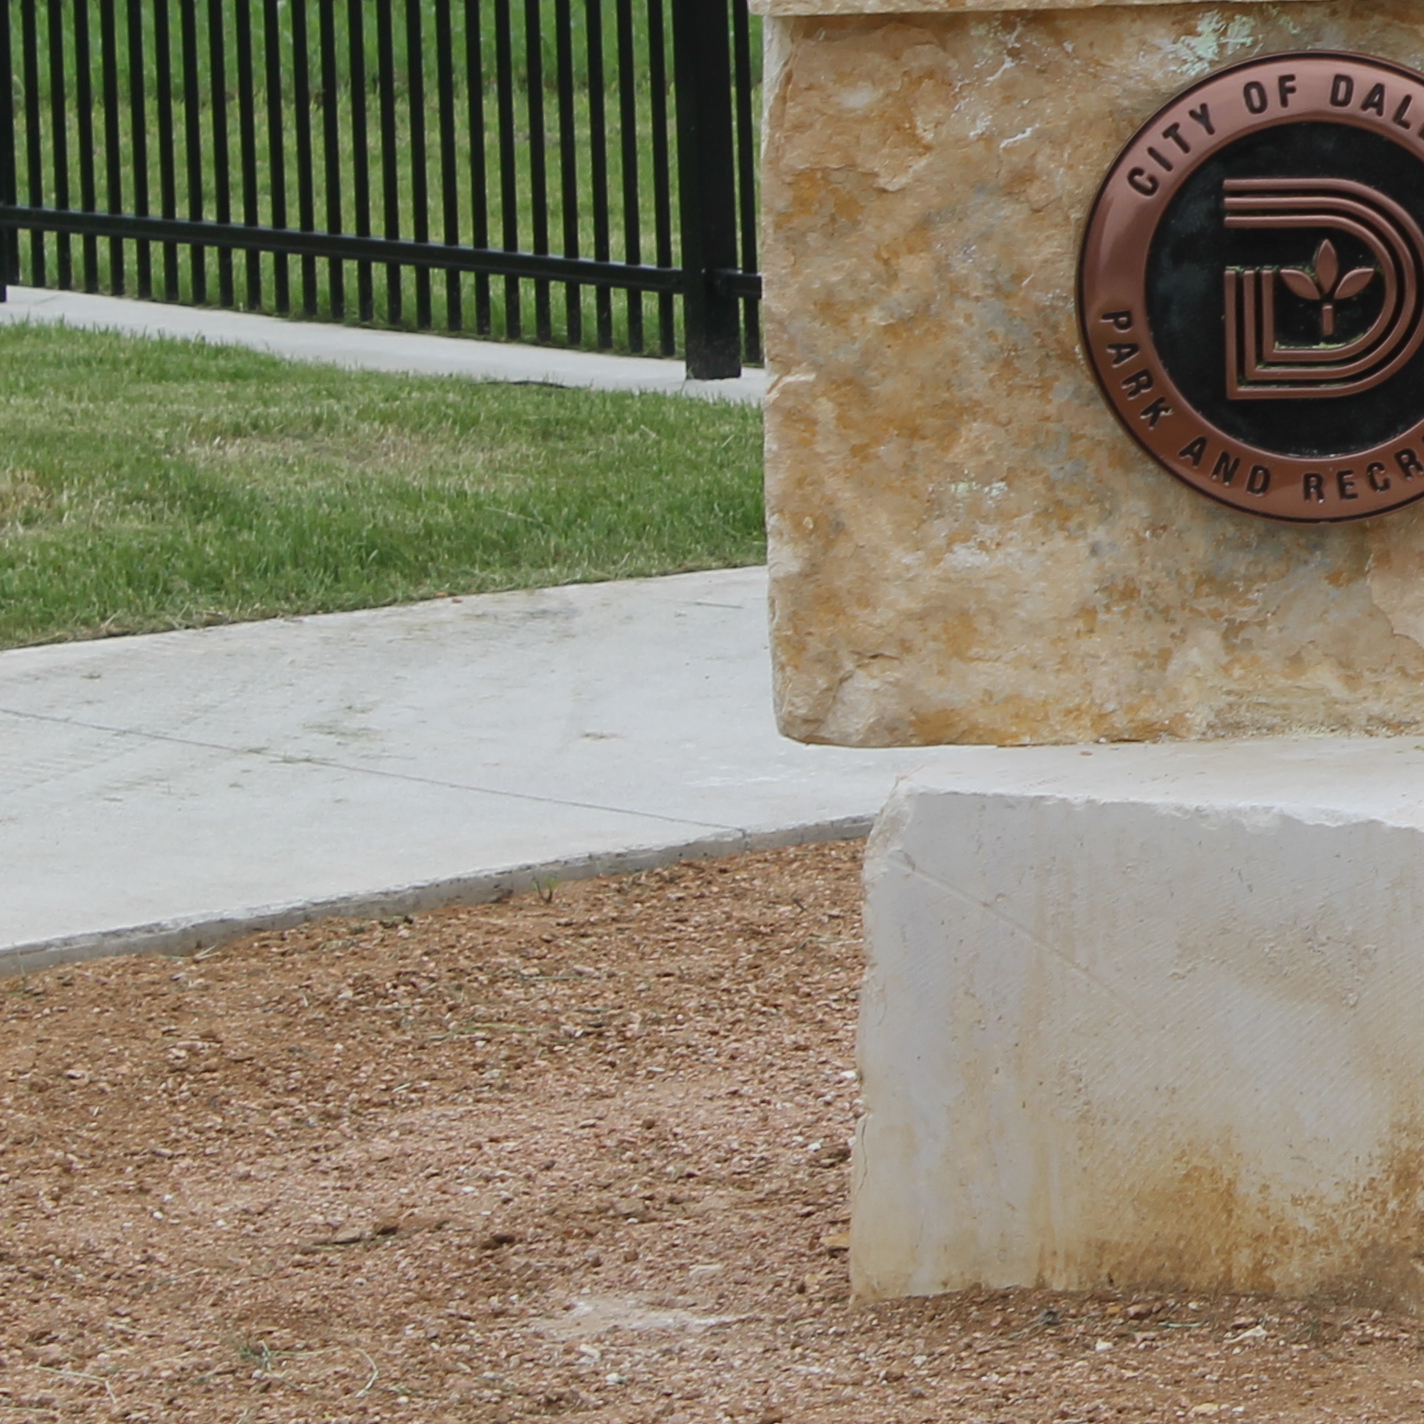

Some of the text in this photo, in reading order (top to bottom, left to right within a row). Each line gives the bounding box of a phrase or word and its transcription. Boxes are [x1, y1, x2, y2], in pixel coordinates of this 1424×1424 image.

[1127, 103, 1216, 196] CITY
[1243, 74, 1297, 114] OF
[1101, 310, 1172, 429] PARK
[1179, 437, 1271, 496] AND
